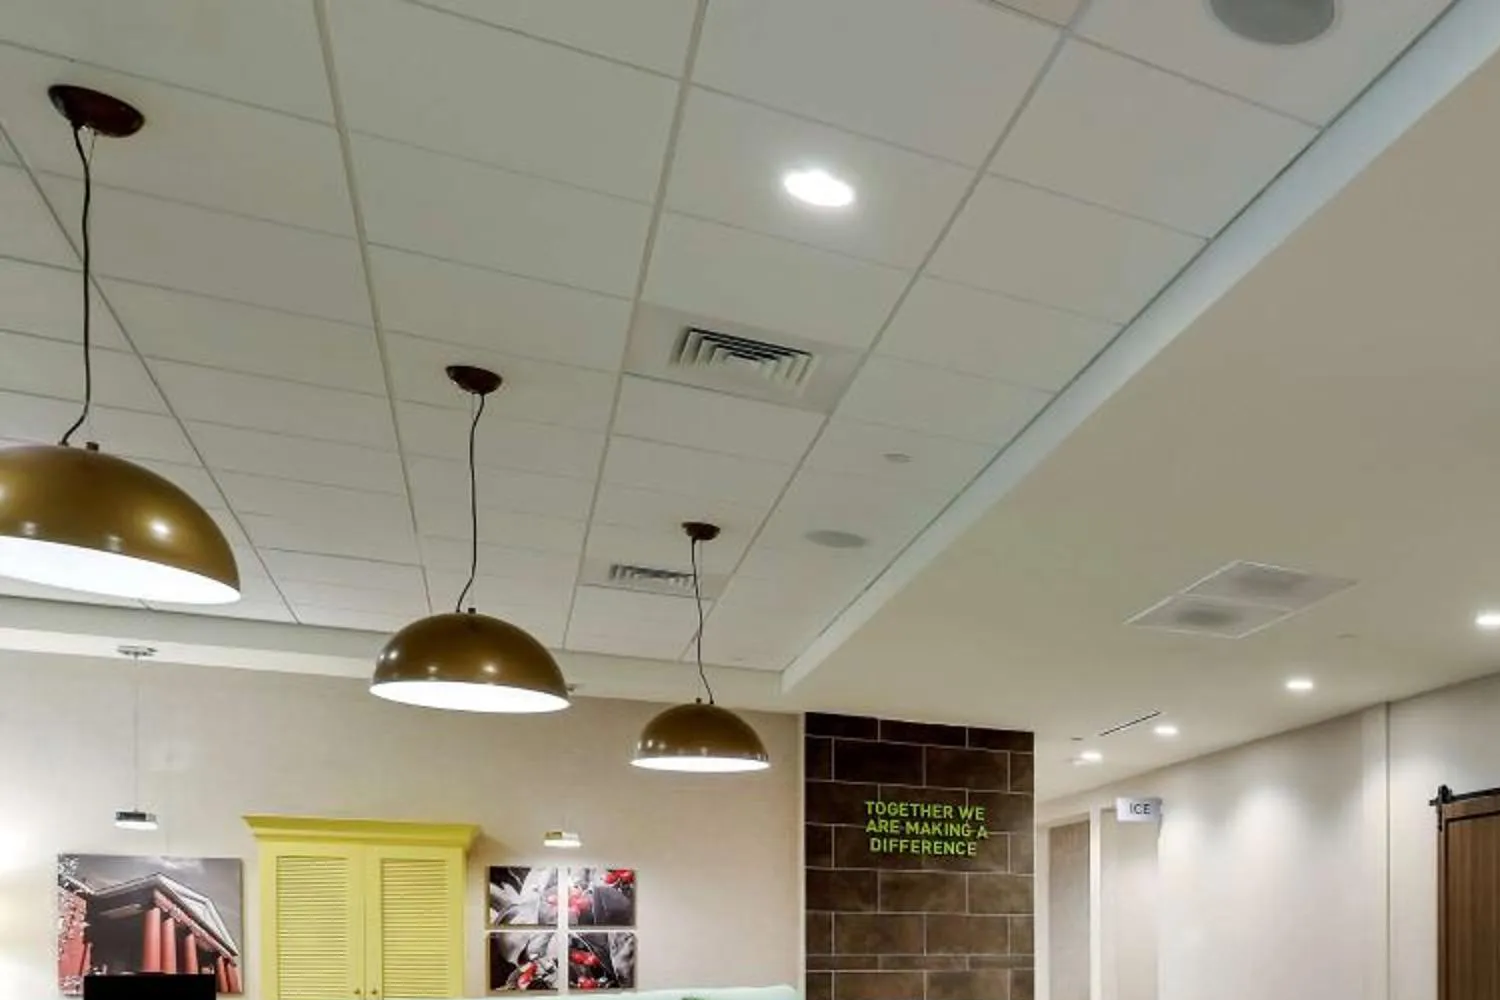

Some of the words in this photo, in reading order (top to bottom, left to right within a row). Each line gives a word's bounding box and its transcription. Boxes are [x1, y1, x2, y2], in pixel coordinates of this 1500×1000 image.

[865, 801, 953, 819] TOGETHER
[959, 806, 985, 821] WE
[1129, 803, 1151, 814] ICE
[866, 819, 900, 834] ARE
[906, 821, 972, 837] MAKING
[976, 825, 989, 839] A
[870, 837, 977, 856] DIFFERENCE
